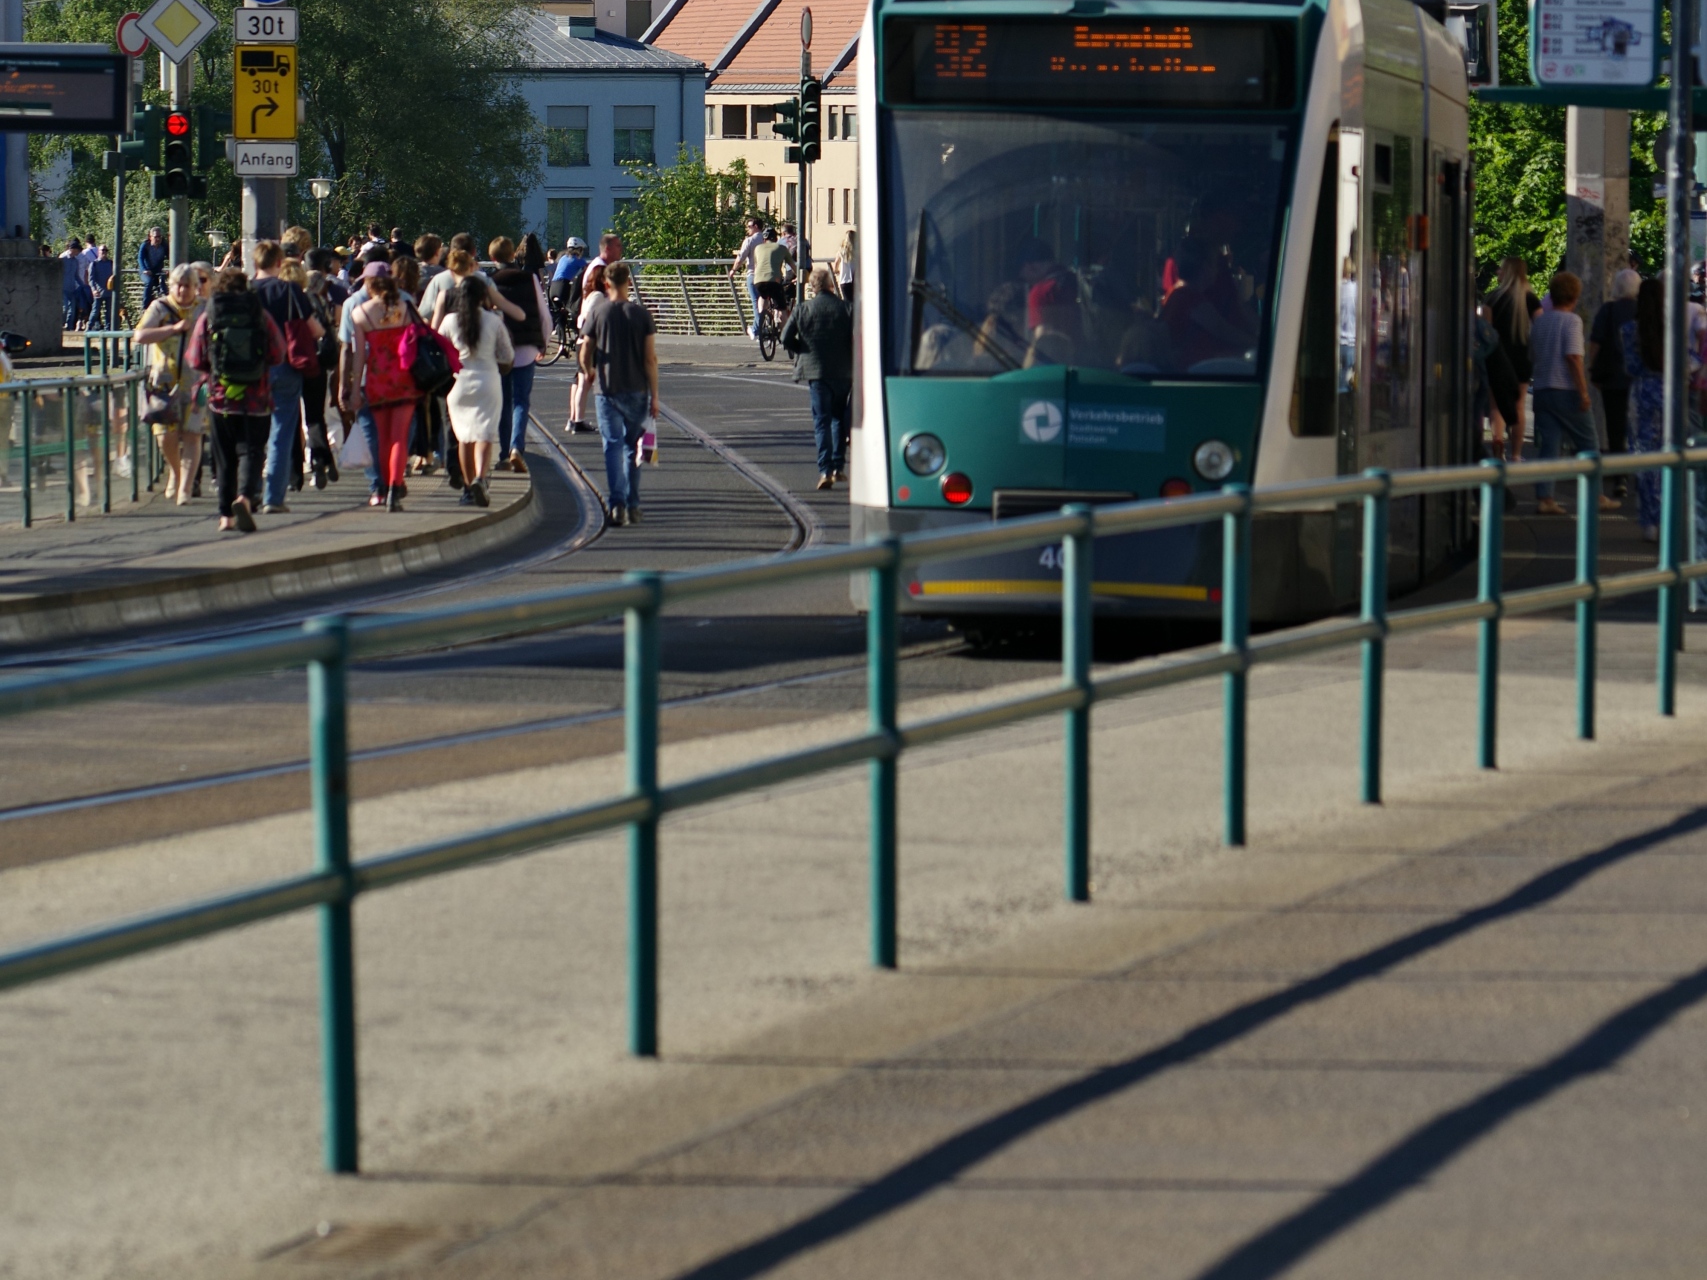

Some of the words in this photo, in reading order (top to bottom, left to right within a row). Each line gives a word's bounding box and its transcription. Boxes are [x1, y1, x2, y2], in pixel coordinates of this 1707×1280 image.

[936, 25, 987, 77] 92
[241, 152, 293, 169] Anfang
[1069, 408, 1164, 425] Verkehrsbetrieb
